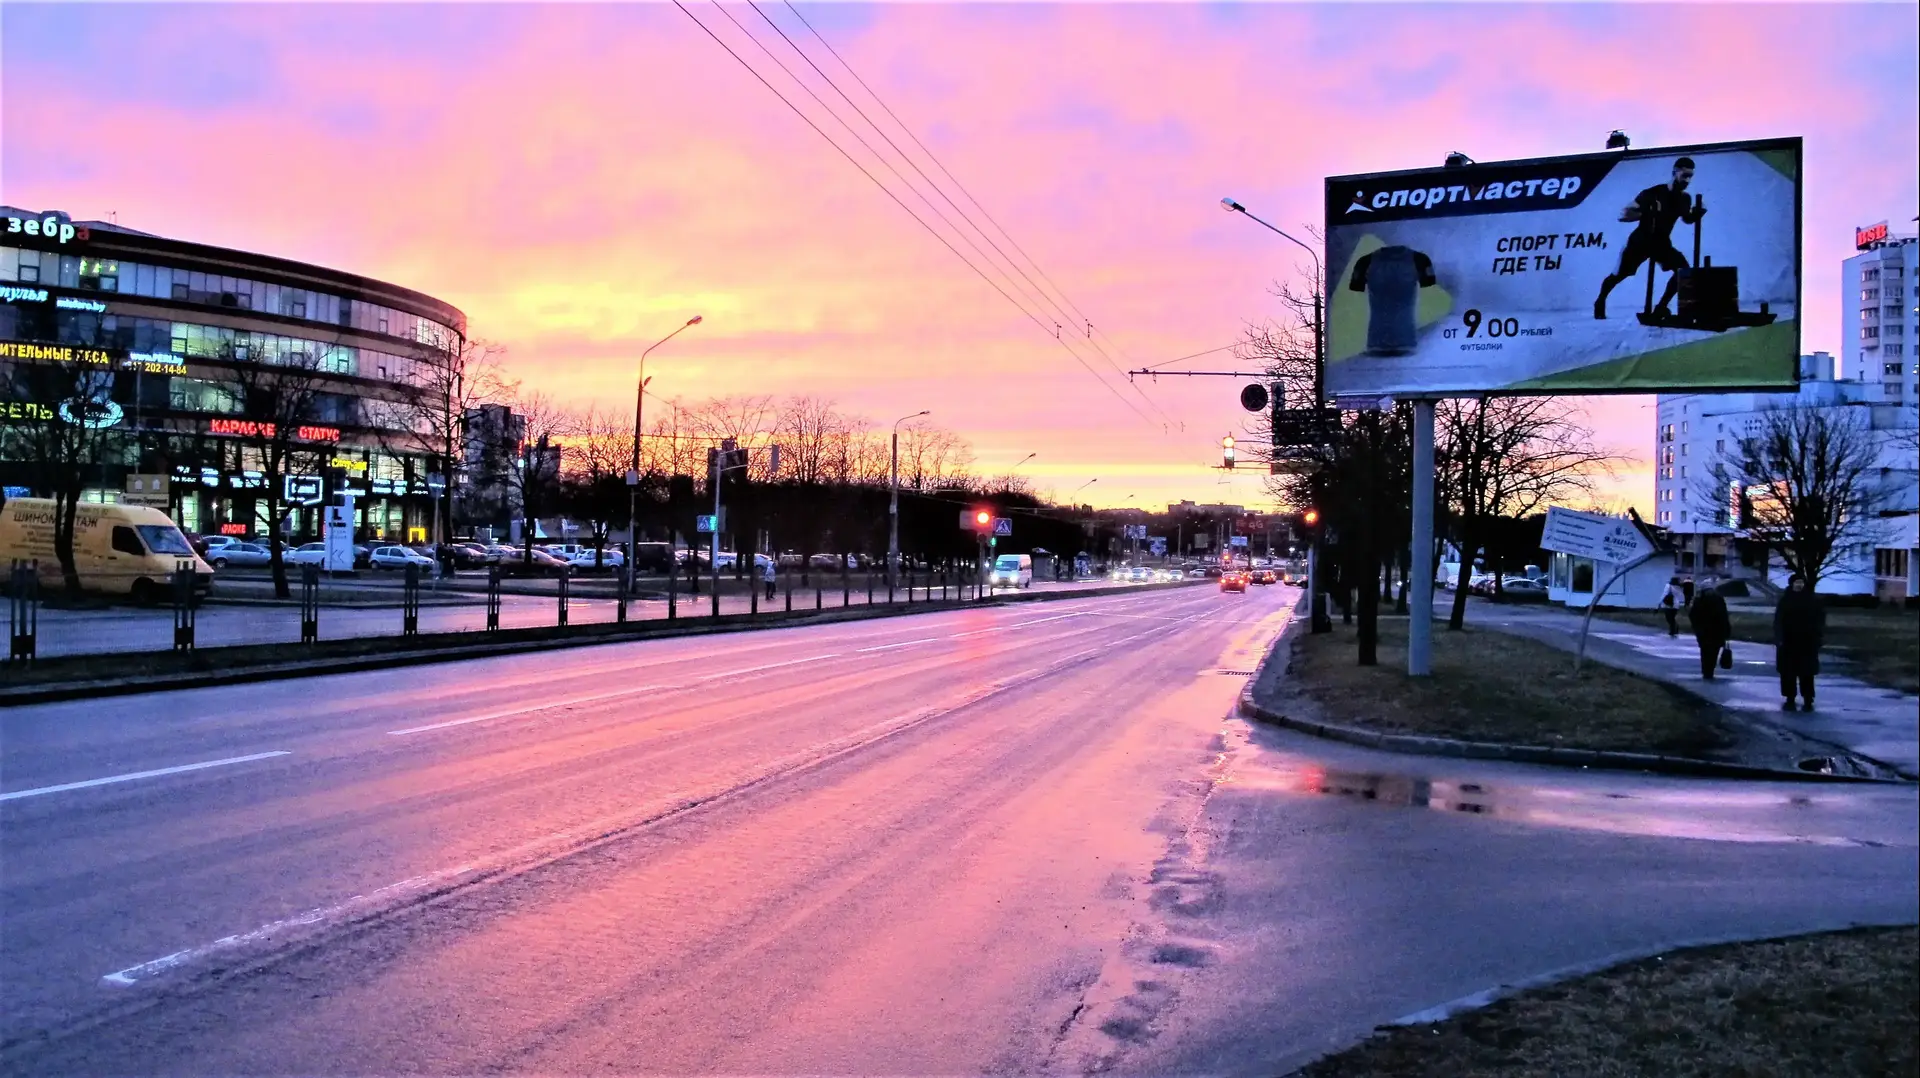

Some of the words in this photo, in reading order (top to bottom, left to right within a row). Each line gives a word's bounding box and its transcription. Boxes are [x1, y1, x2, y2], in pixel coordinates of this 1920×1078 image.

[1372, 176, 1581, 209] спортмастер
[7, 216, 90, 243] зебра
[1496, 234, 1559, 253] СПОРТ
[1564, 232, 1607, 250] ТАМ,
[1492, 257, 1529, 276] ГДЕ
[1534, 254, 1562, 271] ТЫ
[1521, 326, 1553, 336] РУБЛЕЙ
[1460, 343, 1503, 351] ФУТБОЛКИ
[299, 426, 340, 441] СТАТУС
[13, 511, 98, 528] ШИНОМТАЖ
